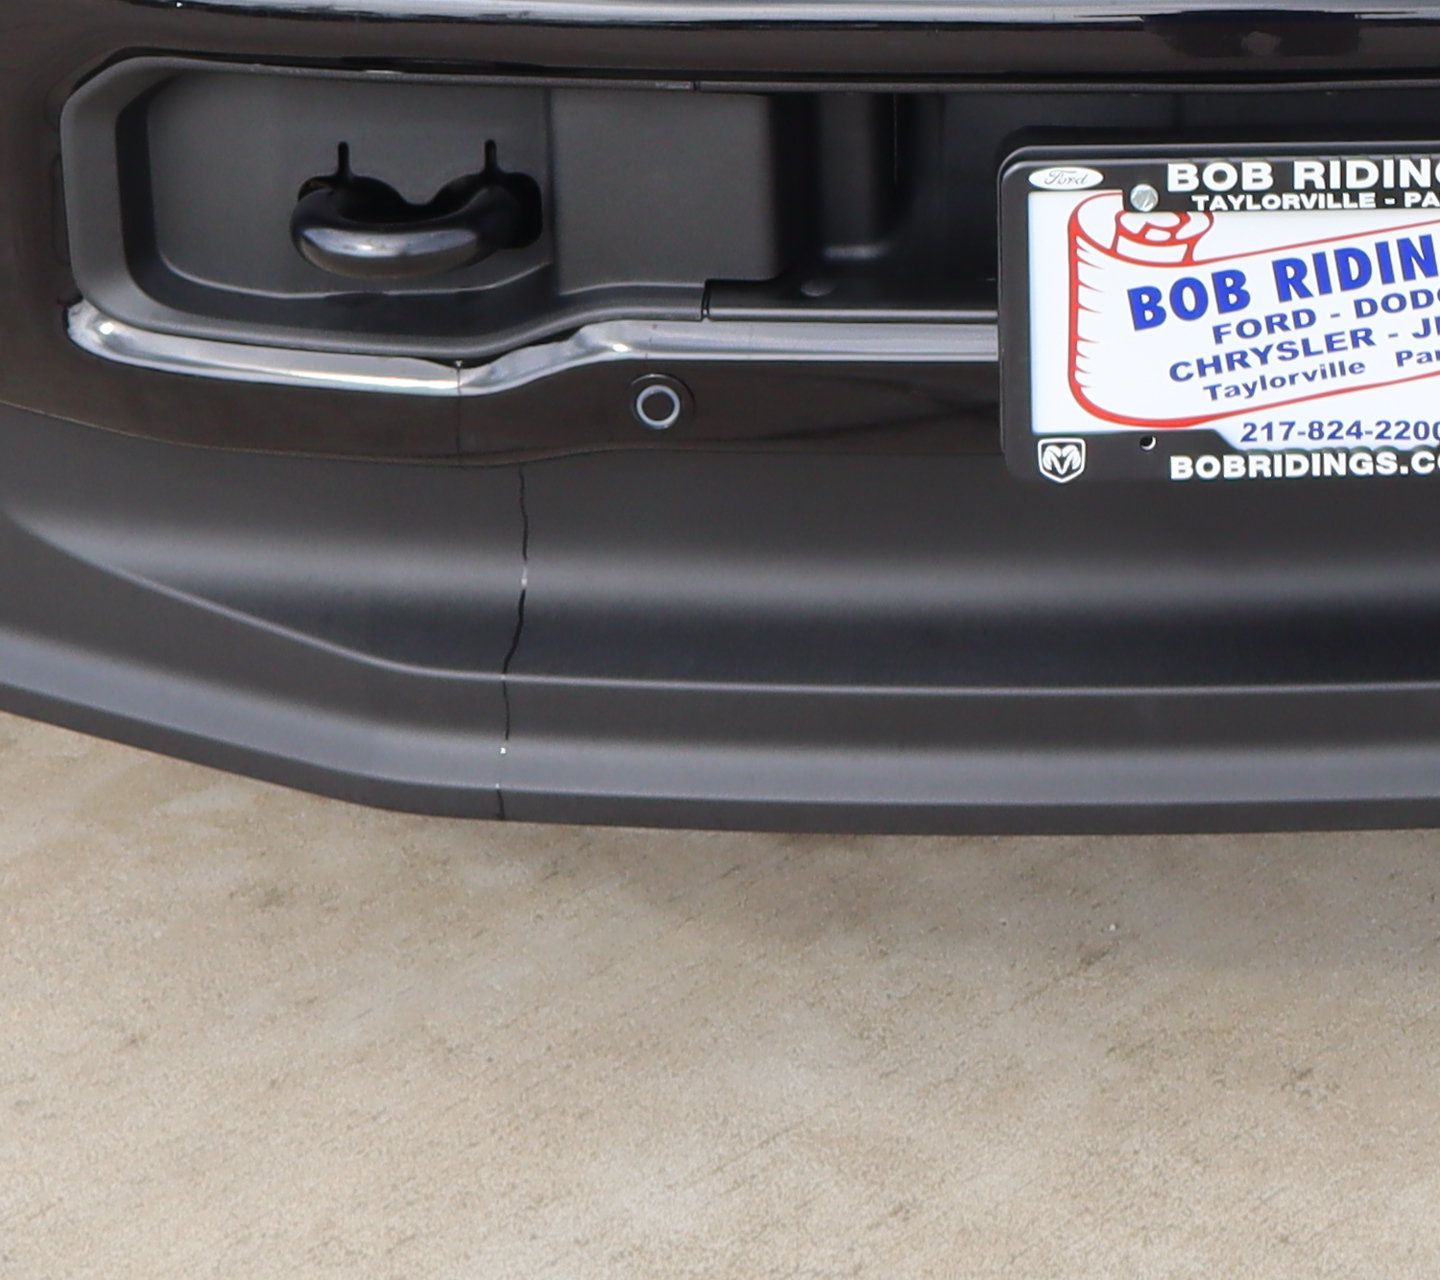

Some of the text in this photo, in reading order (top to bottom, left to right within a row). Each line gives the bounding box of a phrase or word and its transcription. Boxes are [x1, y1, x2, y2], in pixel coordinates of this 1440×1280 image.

[1043, 169, 1090, 186] Ford
[1167, 161, 1274, 192] BOB
[1192, 192, 1376, 211] TAYLORVILLE
[1127, 269, 1251, 331] BOB
[1212, 307, 1317, 345] FORD
[1169, 327, 1377, 383] CHRYSLER
[1203, 359, 1366, 401] Taylorville
